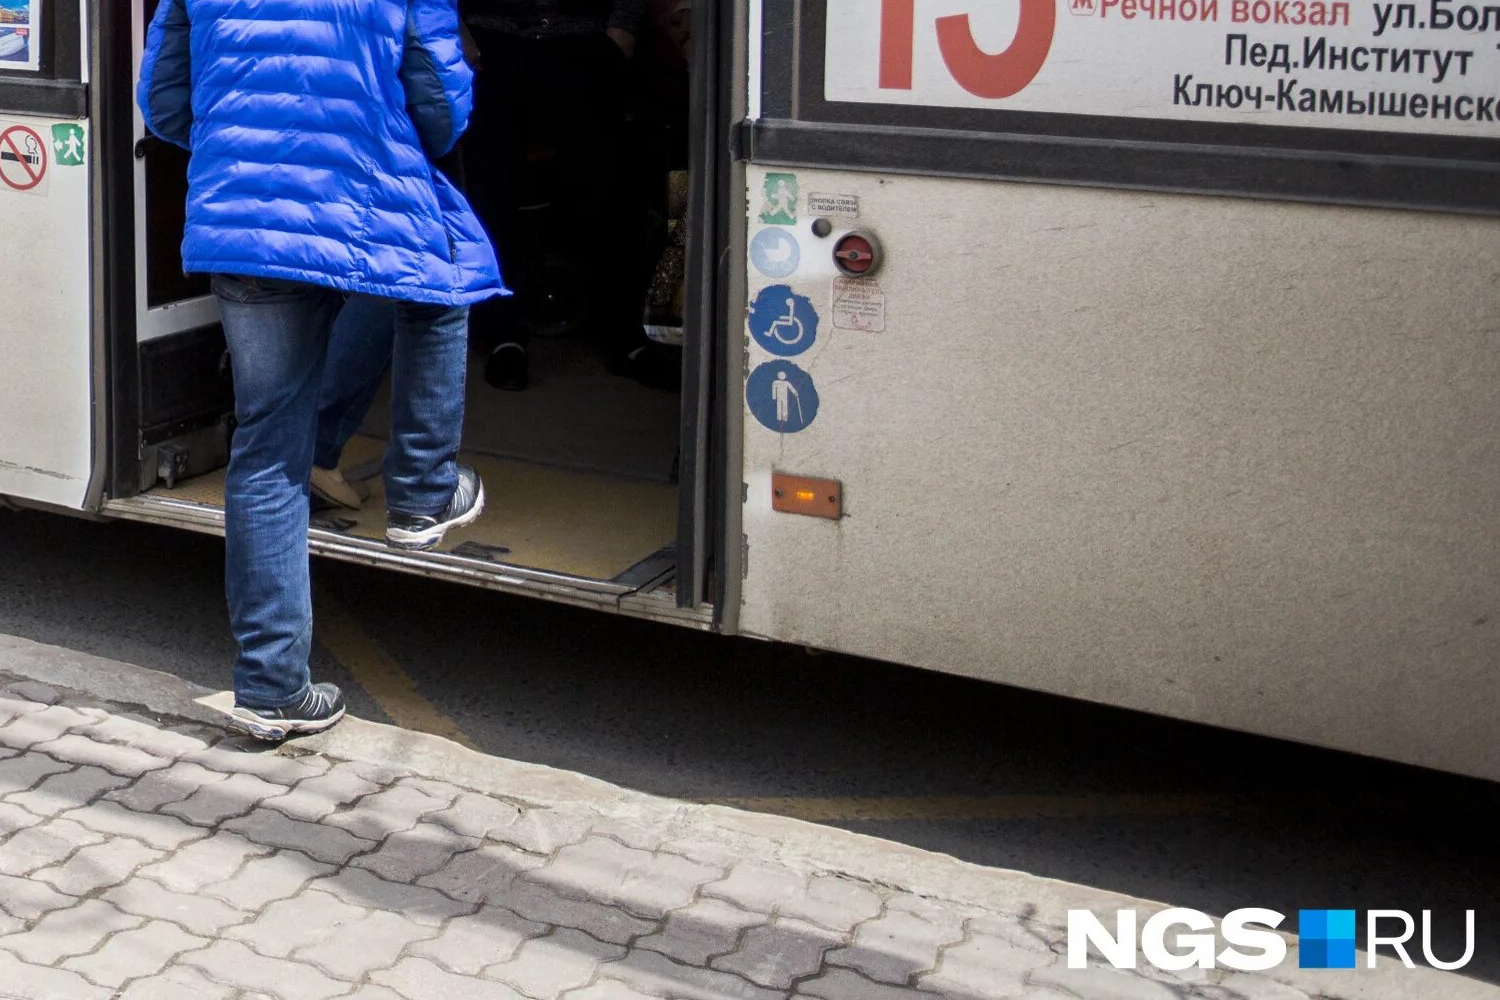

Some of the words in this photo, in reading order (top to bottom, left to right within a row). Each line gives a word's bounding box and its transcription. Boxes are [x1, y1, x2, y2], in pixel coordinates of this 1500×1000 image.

[1231, 0, 1350, 27] вокзал
[1225, 33, 1473, 83] Пед.Институт
[1173, 73, 1500, 122] Ключ-Камышенск
